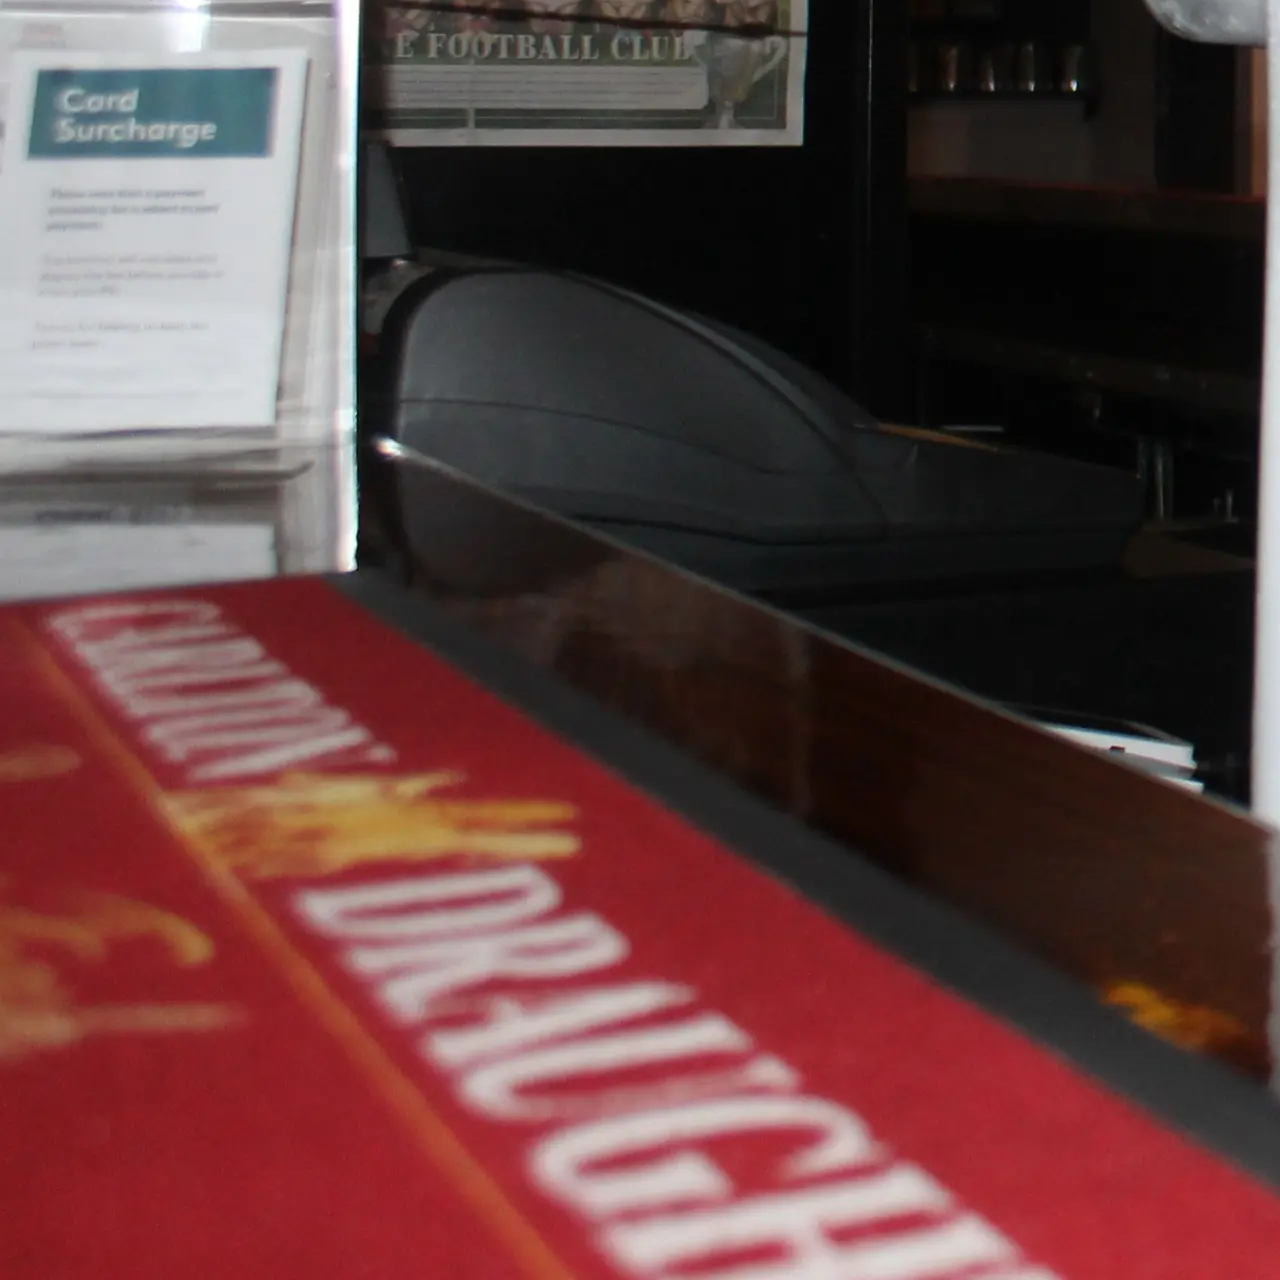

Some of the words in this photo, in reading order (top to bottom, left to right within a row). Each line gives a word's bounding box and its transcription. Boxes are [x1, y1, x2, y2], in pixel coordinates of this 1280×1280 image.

[427, 31, 602, 61] FOOTBALL
[56, 88, 140, 115] Card
[53, 118, 218, 149] Surcharge
[292, 863, 1066, 1280] DRAUGH
